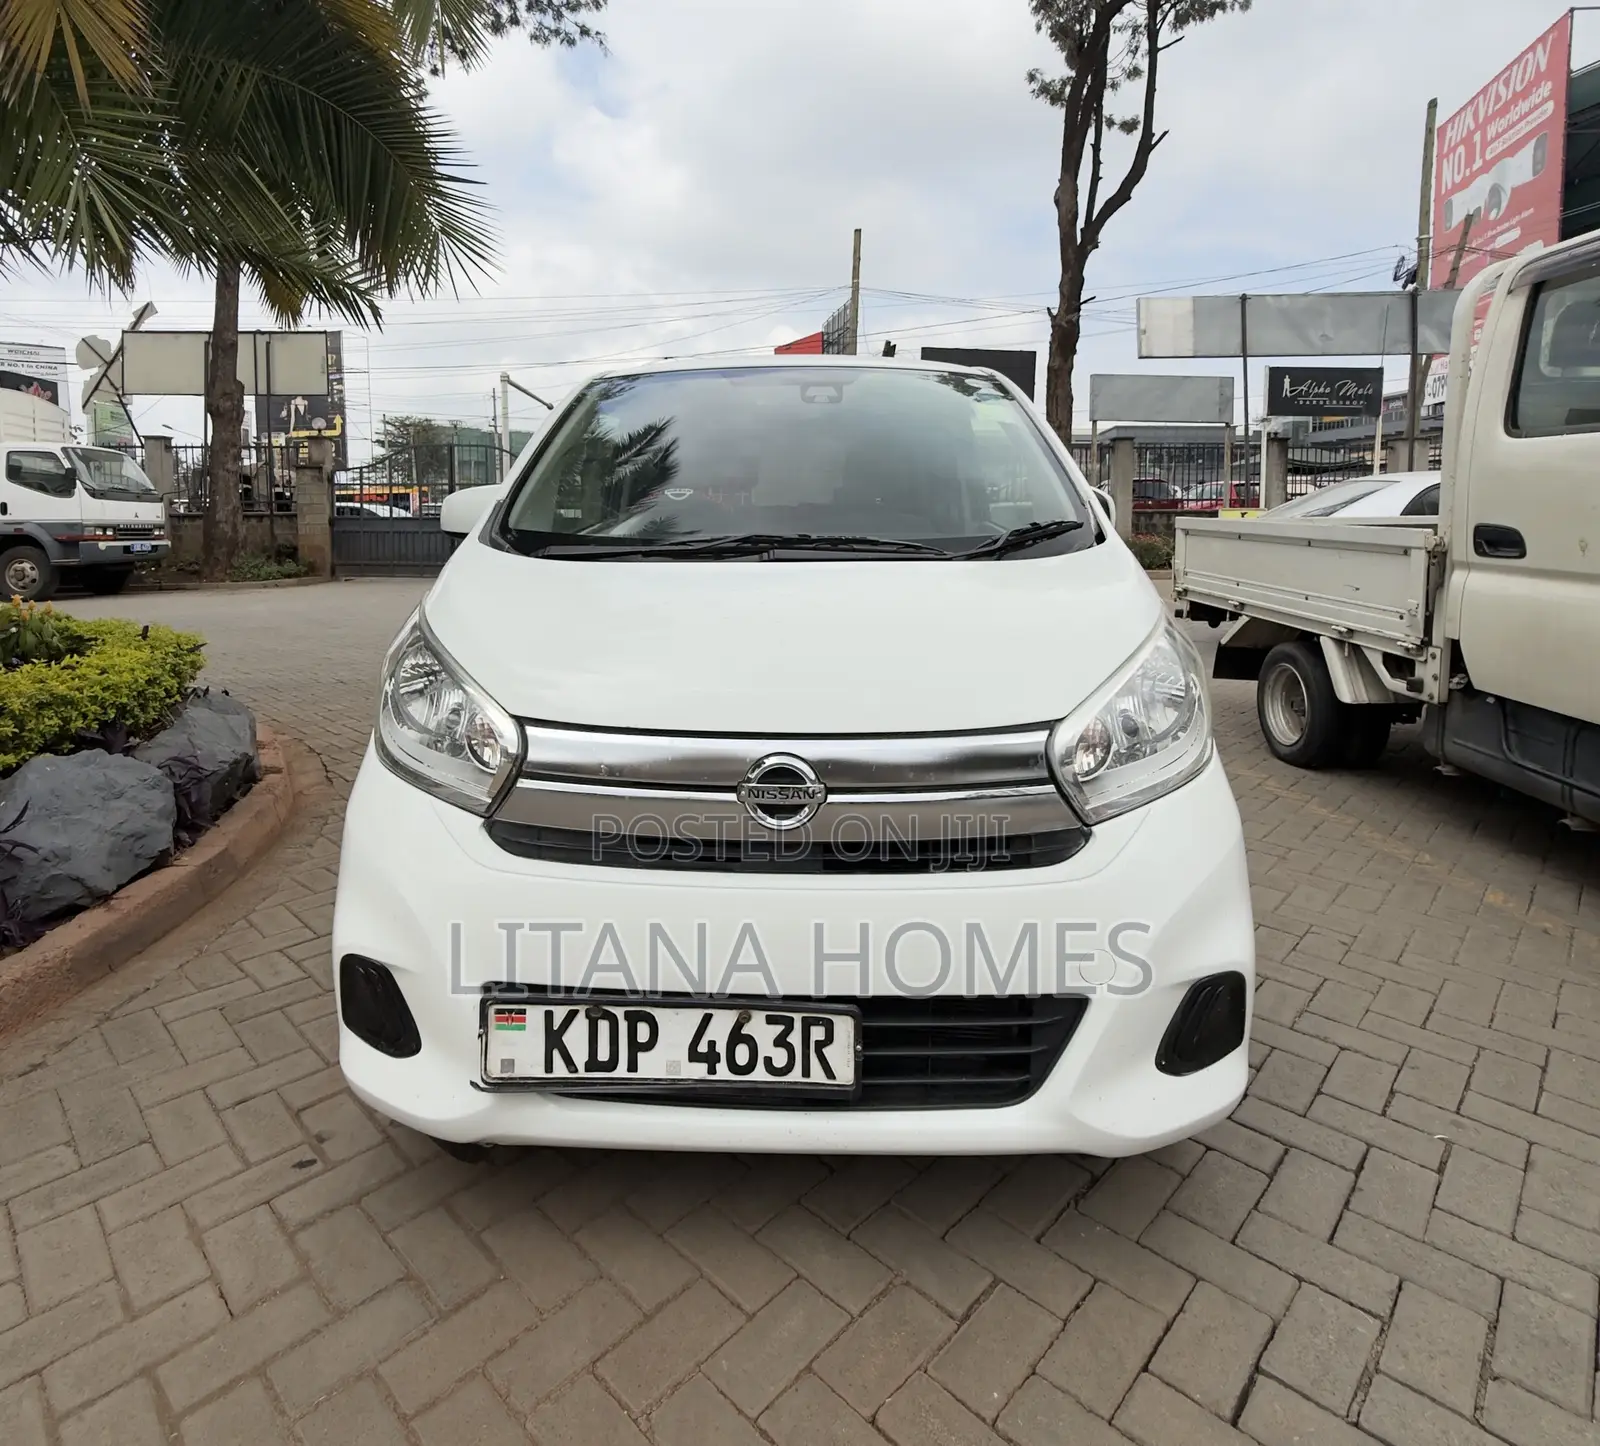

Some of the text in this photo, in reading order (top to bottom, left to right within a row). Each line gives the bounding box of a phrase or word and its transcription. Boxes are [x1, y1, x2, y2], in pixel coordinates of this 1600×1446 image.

[1441, 130, 1483, 195] NO.1
[1487, 80, 1552, 142] Worldwide
[1444, 32, 1555, 153] HIKVISION
[747, 788, 817, 800] NISSAN
[544, 1007, 660, 1075] KDP
[687, 1012, 837, 1081] 463R
